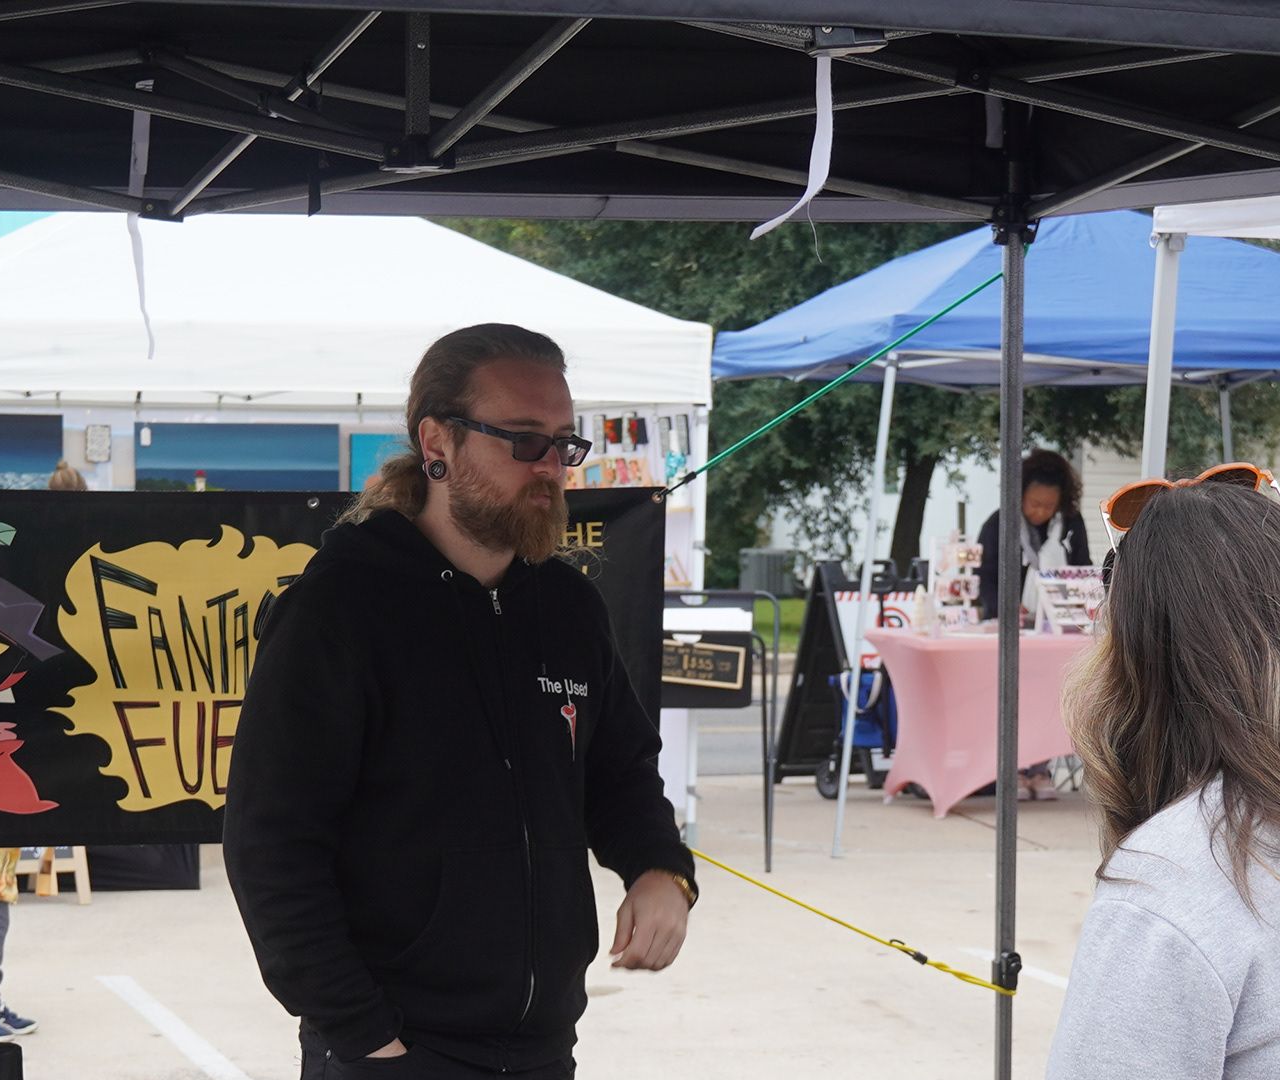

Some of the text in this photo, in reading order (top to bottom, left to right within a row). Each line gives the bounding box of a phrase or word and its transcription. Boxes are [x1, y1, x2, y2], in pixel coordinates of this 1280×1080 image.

[562, 522, 604, 547] HE
[537, 677, 588, 697] The Used
[113, 700, 245, 799] FUE
